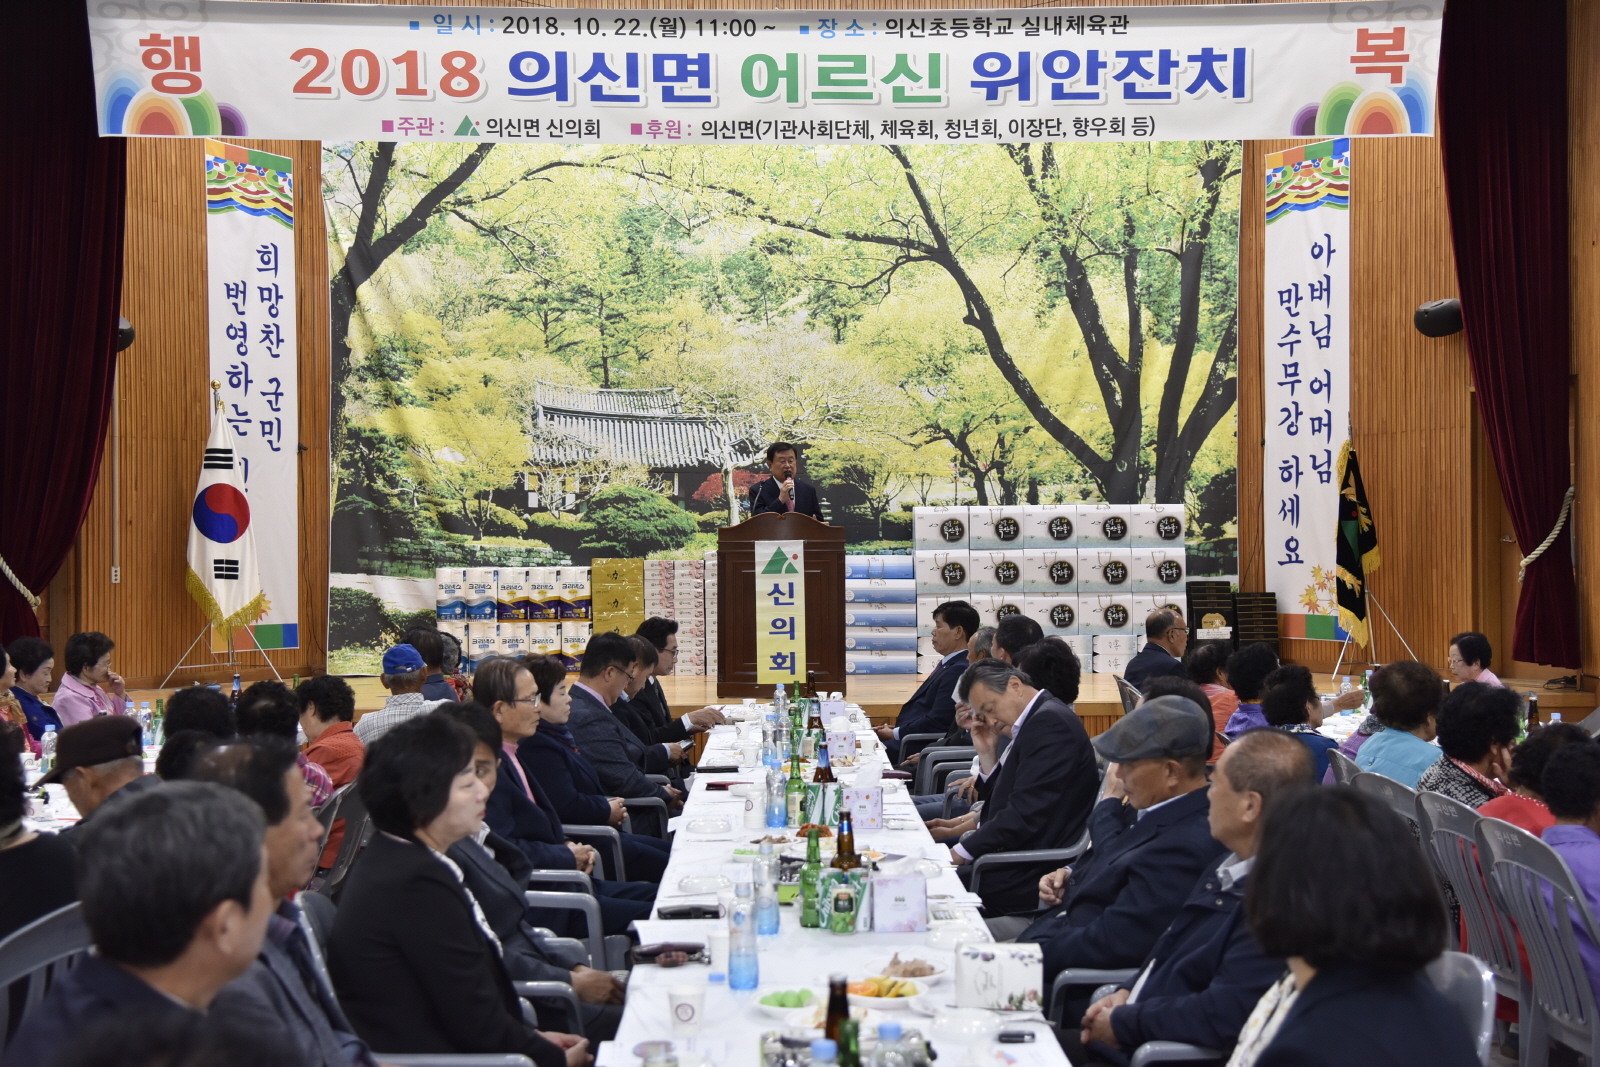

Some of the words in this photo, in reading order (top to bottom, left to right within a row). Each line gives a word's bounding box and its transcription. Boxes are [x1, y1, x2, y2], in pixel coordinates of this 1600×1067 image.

[138, 32, 204, 95] 행
[501, 16, 565, 36] 2018.
[573, 17, 606, 36] 10.
[613, 16, 687, 38] 22.(월)
[884, 16, 1014, 39] 의신초등학교
[1020, 15, 1130, 37] 실내체육관
[1348, 25, 1411, 85] 복
[288, 46, 481, 98] 2018
[507, 50, 714, 104] 의신면
[740, 51, 943, 104] 어르신
[969, 47, 1248, 102] 위안잔치
[486, 118, 541, 138] 의신면
[546, 118, 600, 139] 신의회
[700, 119, 873, 141] 의신면(기관사회단체,
[880, 119, 939, 140] 체육회,
[944, 118, 1003, 139] 청년회,
[1008, 118, 1067, 139] 이장단,
[1072, 117, 1126, 138] 향우회
[1131, 116, 1155, 138] 등)
[256, 242, 286, 360] 희망찬
[1307, 232, 1337, 349] 아버님
[224, 280, 254, 437] 번영하는
[1276, 281, 1305, 438] 만수무강
[259, 376, 285, 453] 군민
[1308, 368, 1333, 485] 어머님
[1276, 454, 1305, 568] 하세요
[766, 581, 797, 676] 신의회
